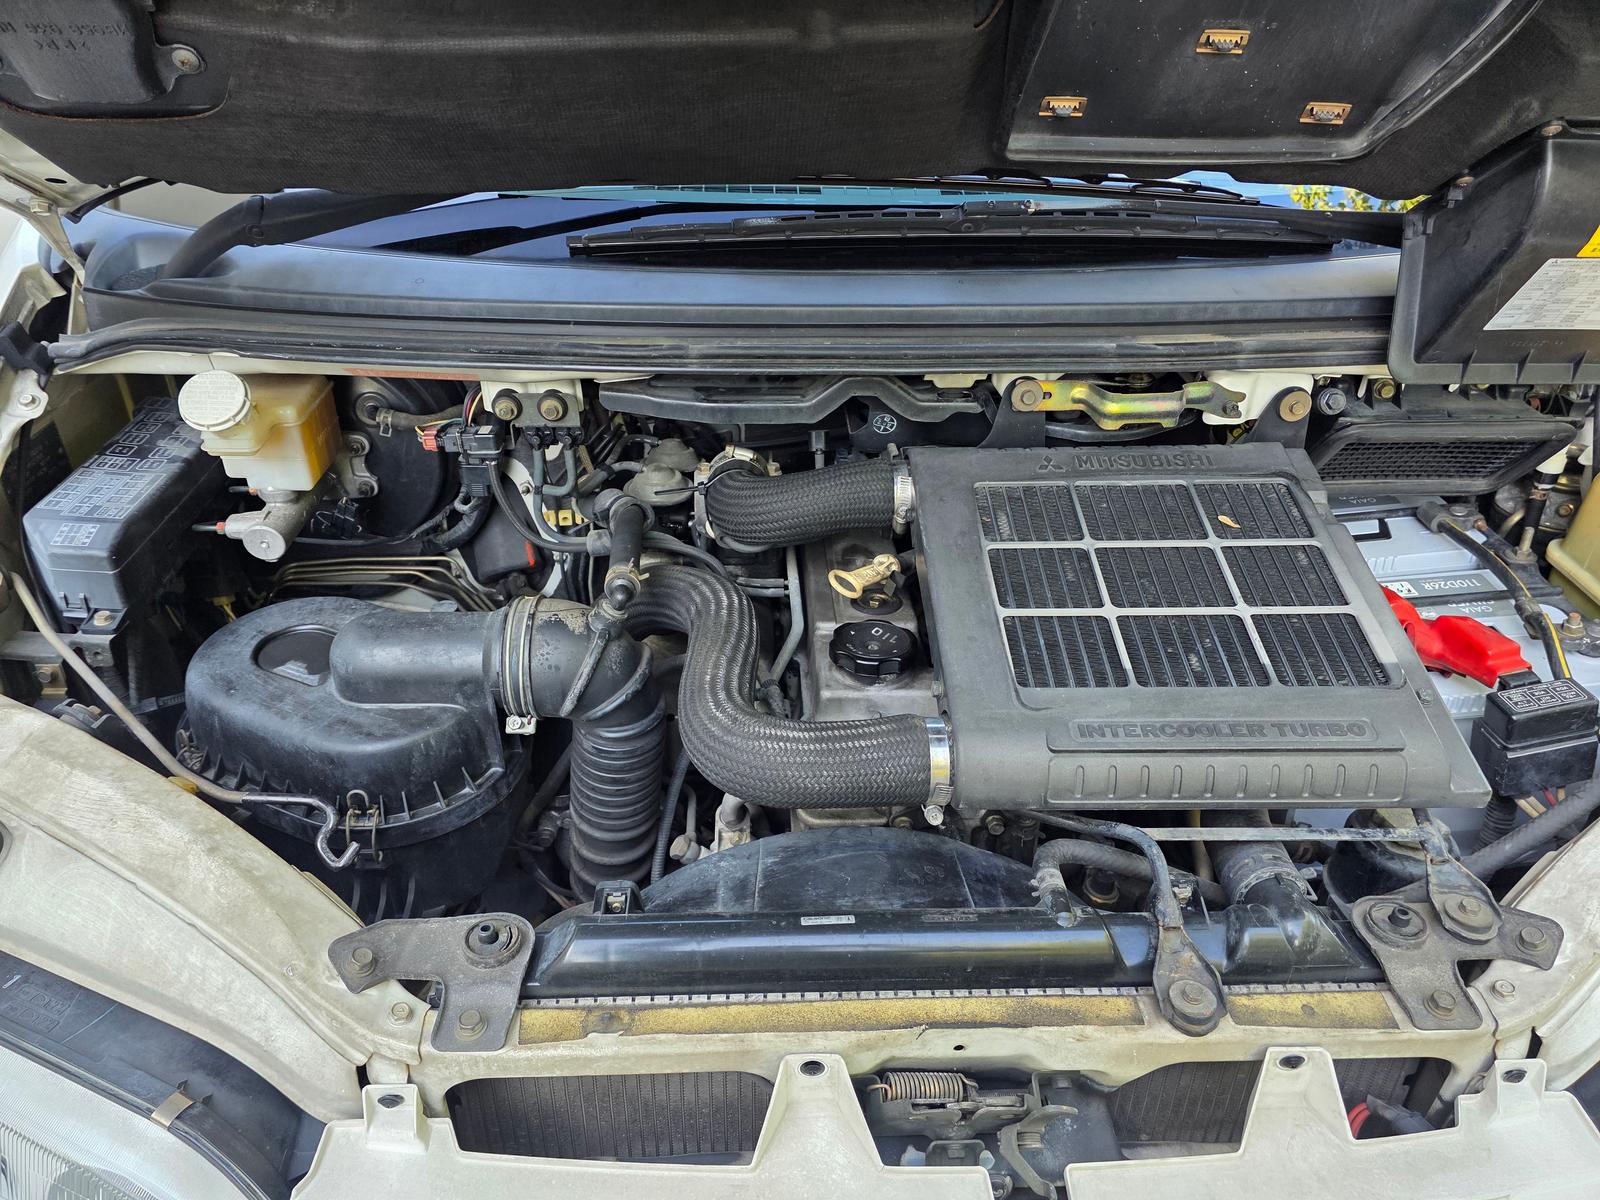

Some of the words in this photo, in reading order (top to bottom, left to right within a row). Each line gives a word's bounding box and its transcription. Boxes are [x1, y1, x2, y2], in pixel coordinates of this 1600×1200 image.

[1074, 453, 1215, 469] MITSUBISHI
[1421, 579, 1482, 591] 110D26R
[1459, 604, 1493, 614] GAIA
[871, 626, 898, 644] OIL
[1076, 721, 1268, 738] INTERCOOLER
[1270, 721, 1368, 738] TURBO
